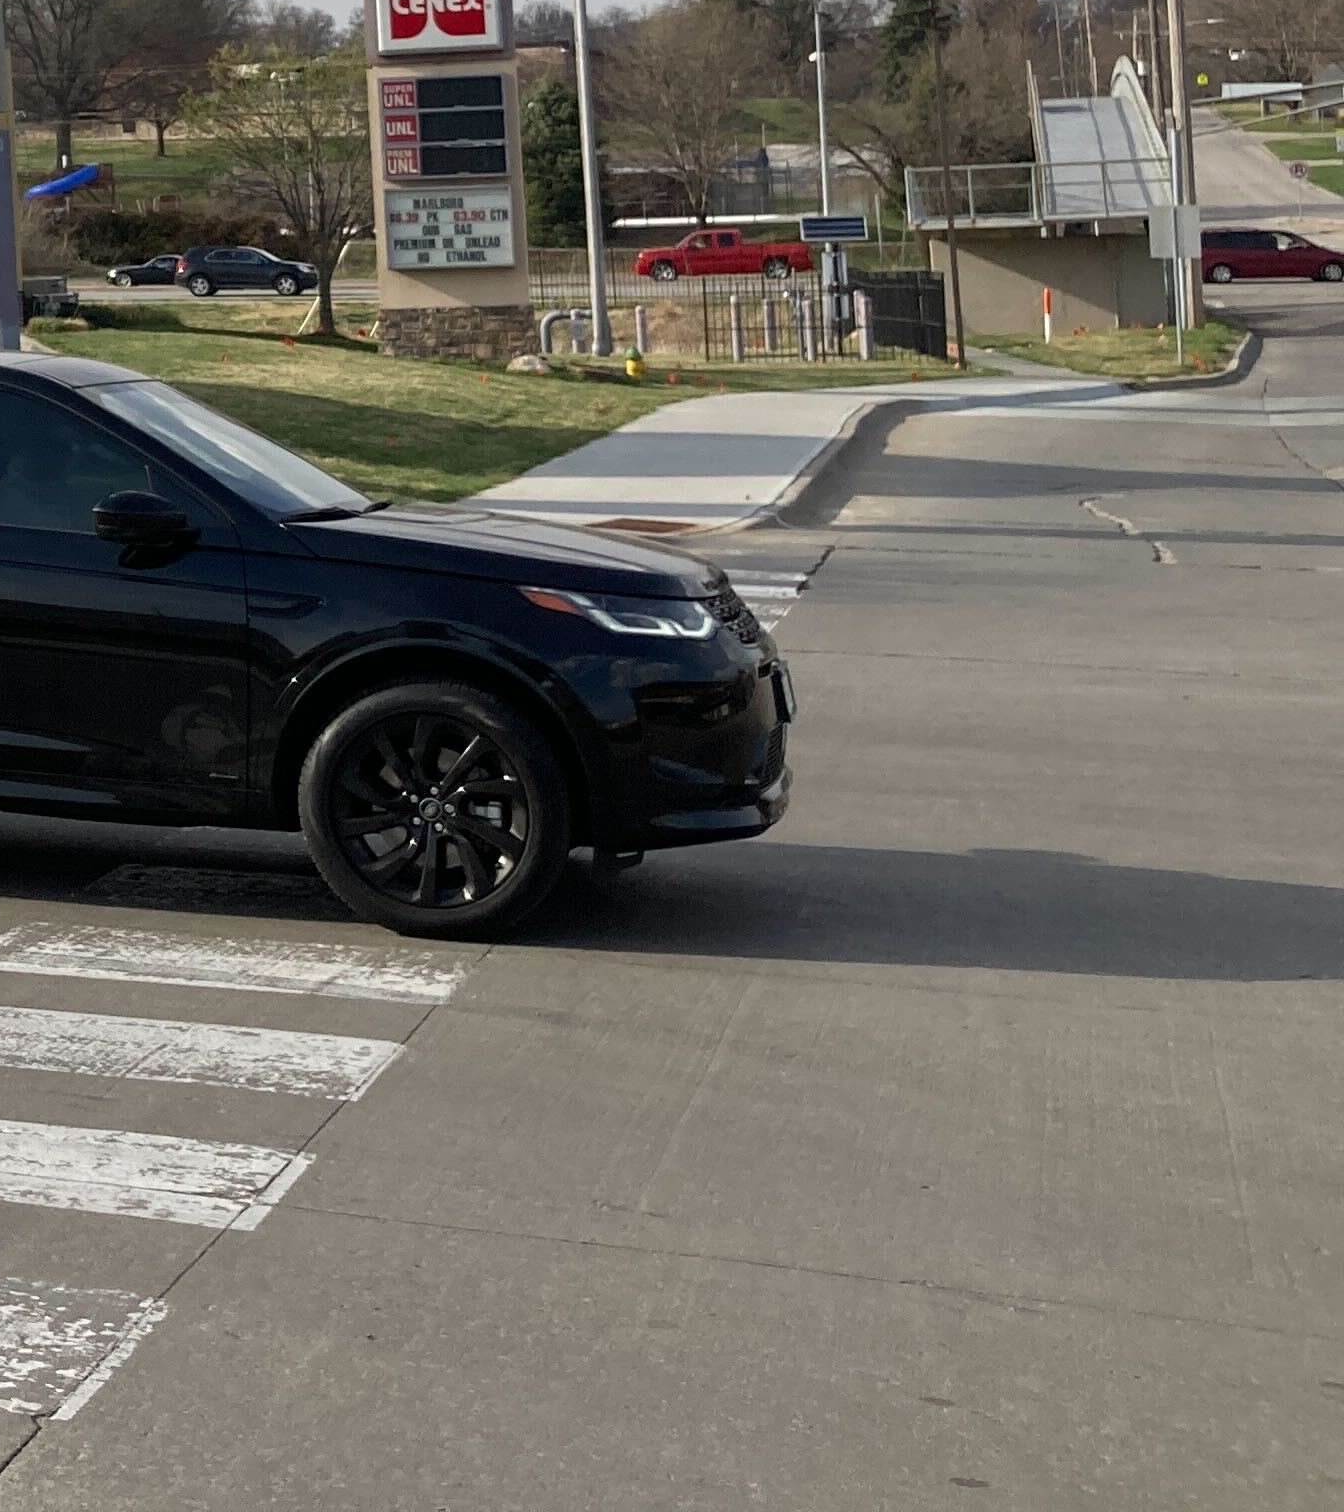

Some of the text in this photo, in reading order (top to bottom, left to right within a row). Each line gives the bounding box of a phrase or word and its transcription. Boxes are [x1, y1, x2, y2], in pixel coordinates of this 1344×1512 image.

[384, 84, 413, 93] SUPER
[384, 94, 414, 107] UNL
[386, 121, 416, 136] UNL
[387, 158, 417, 174] UNL
[413, 198, 463, 209] MARLBORO
[427, 212, 439, 222] PK
[454, 224, 472, 235] GAS
[394, 239, 435, 249] PREMIUM
[465, 237, 500, 248] UNLEAD
[446, 251, 487, 262] ETHANOL
